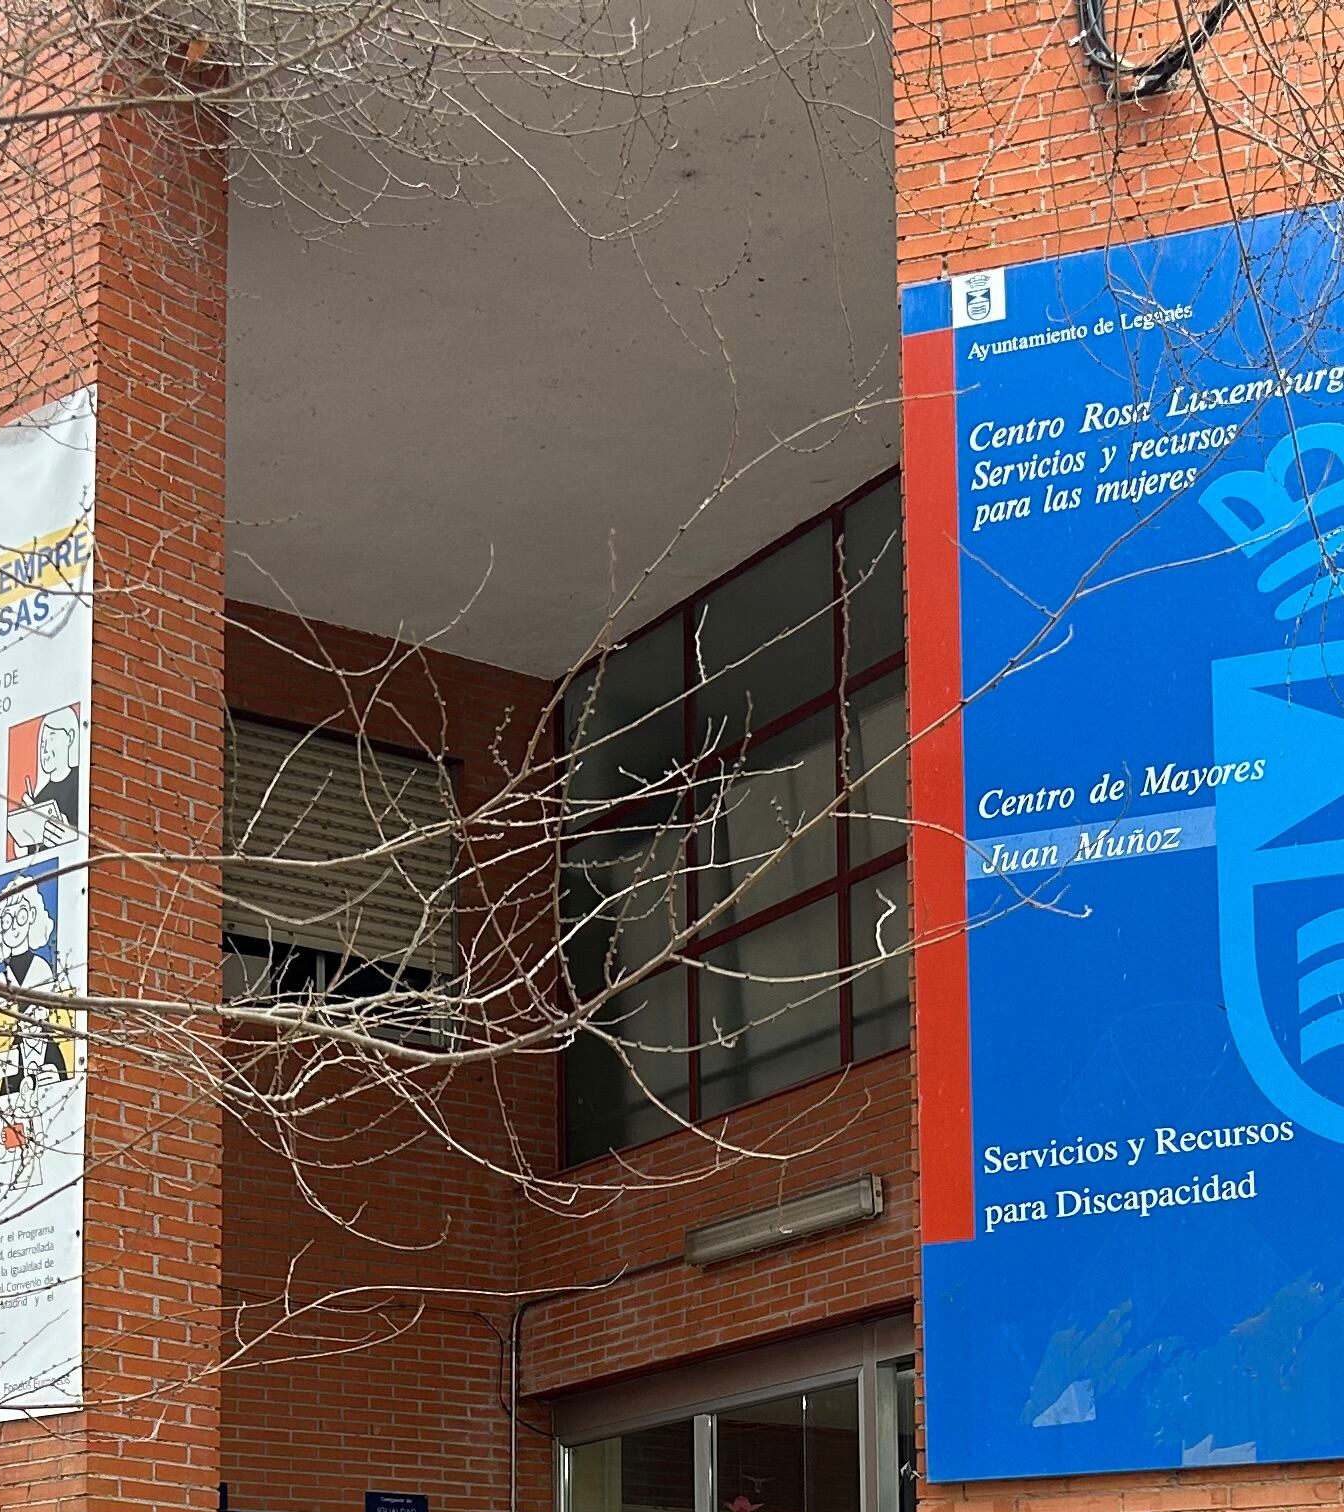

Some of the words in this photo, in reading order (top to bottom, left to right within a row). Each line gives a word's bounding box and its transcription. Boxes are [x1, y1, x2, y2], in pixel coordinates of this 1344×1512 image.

[967, 323, 1089, 361] Ayuntamiento
[1093, 316, 1115, 335] de
[1119, 301, 1194, 332] Leganés
[968, 415, 1065, 453] Centro
[1078, 400, 1152, 434] Rosa
[971, 450, 1086, 493] Servicios
[1099, 444, 1118, 472] y
[1129, 420, 1239, 463] recursos
[972, 499, 1032, 533] para
[1043, 483, 1083, 514] las
[1095, 465, 1198, 510] mujeres
[3, 669, 19, 693] DE
[978, 783, 1075, 820] Centro
[1089, 771, 1126, 803] de
[1140, 755, 1266, 799] Mayores
[981, 843, 1059, 875] Juan
[1075, 822, 1182, 863] Muñoz
[983, 1136, 1118, 1175] Servicios
[1127, 1136, 1146, 1168] y
[1154, 1119, 1294, 1157] Recursos
[984, 1201, 1048, 1233] para
[1055, 1170, 1258, 1220] Discapacidad
[7, 1233, 15, 1244] el
[17, 1226, 55, 1245] Programa
[1, 1267, 9, 1277] la
[44, 1258, 55, 1270] de
[46, 1291, 55, 1303] el
